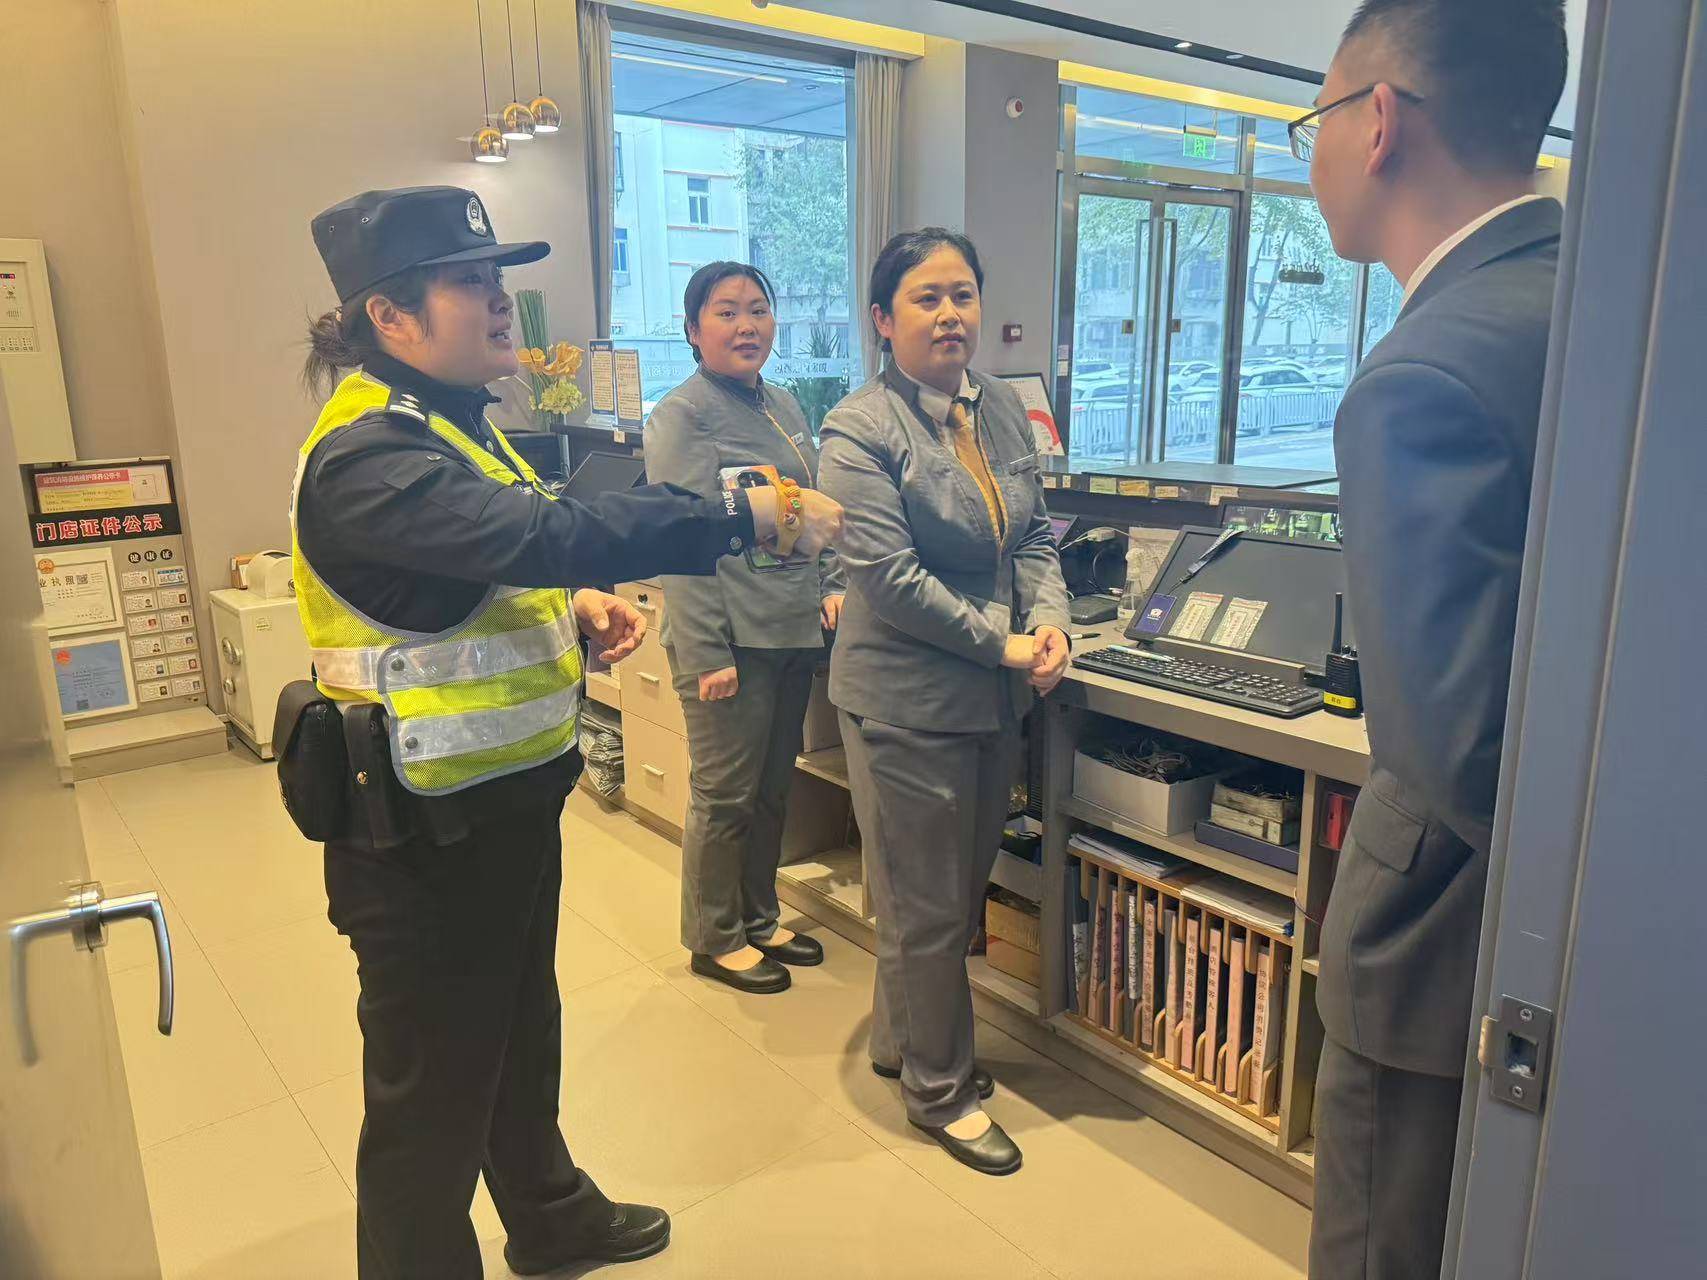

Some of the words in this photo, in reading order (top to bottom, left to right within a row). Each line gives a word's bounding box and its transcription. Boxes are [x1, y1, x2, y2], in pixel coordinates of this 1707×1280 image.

[35, 513, 163, 542] 门店证件公示
